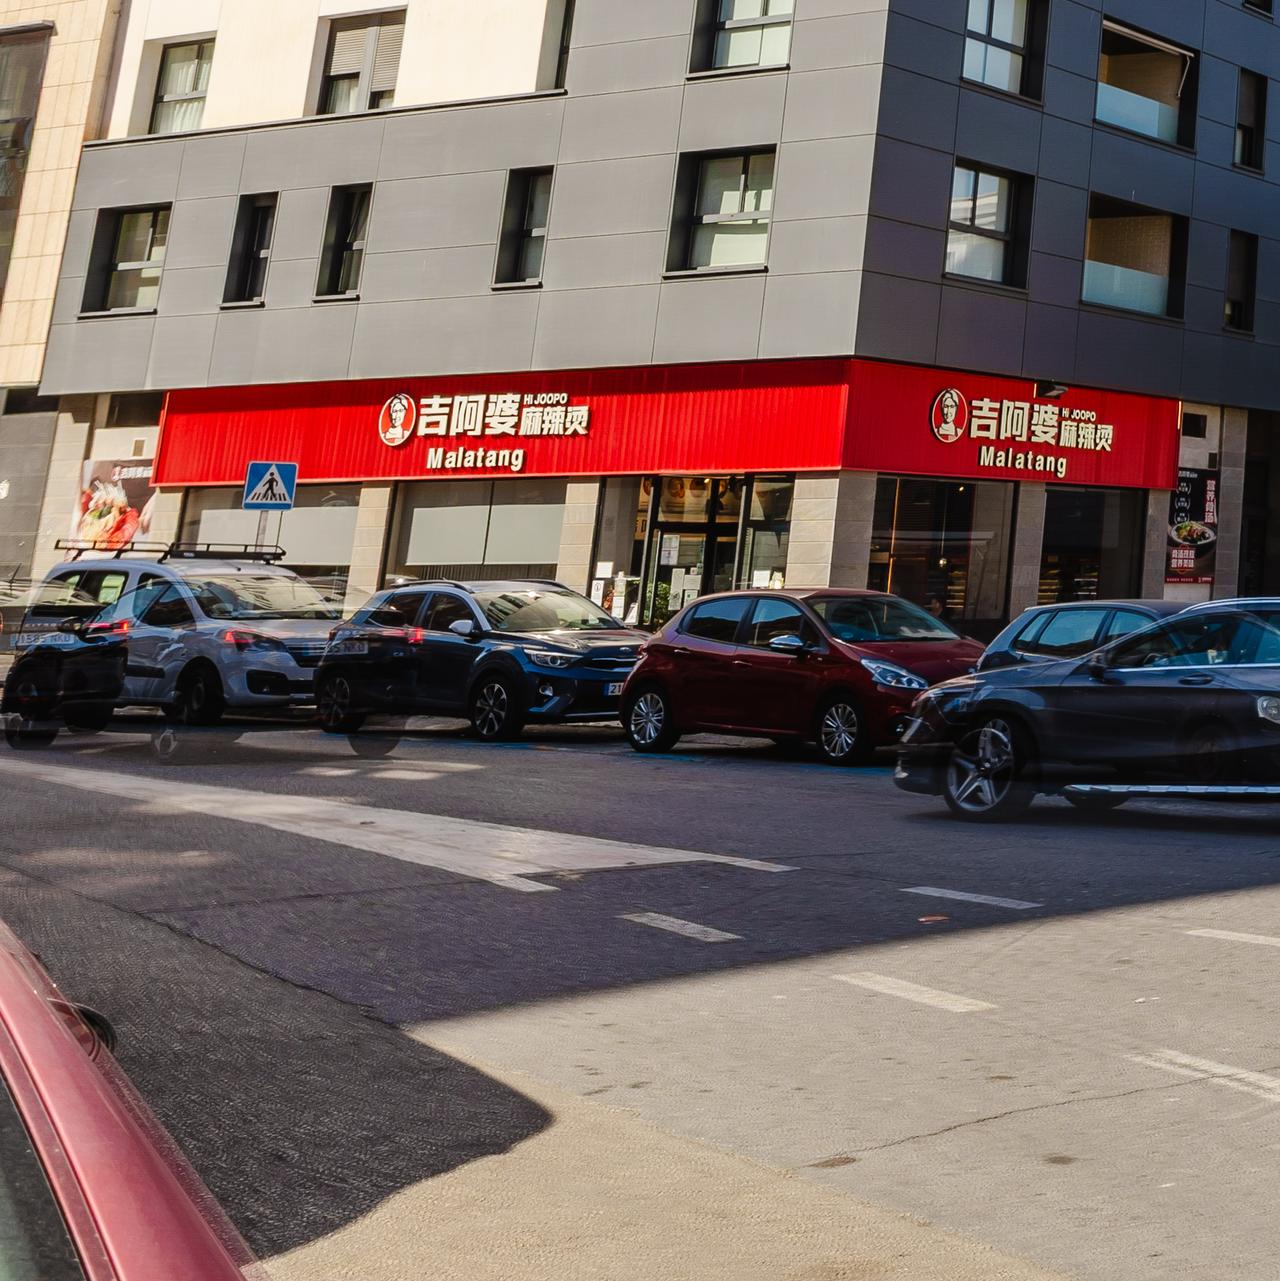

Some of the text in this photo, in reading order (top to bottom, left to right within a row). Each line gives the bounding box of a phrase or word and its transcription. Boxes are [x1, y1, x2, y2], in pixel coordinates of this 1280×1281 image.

[534, 393, 568, 404] JOOPO
[1071, 409, 1096, 422] JOOPO
[427, 447, 524, 471] Malatang
[980, 446, 1067, 478] Malatang
